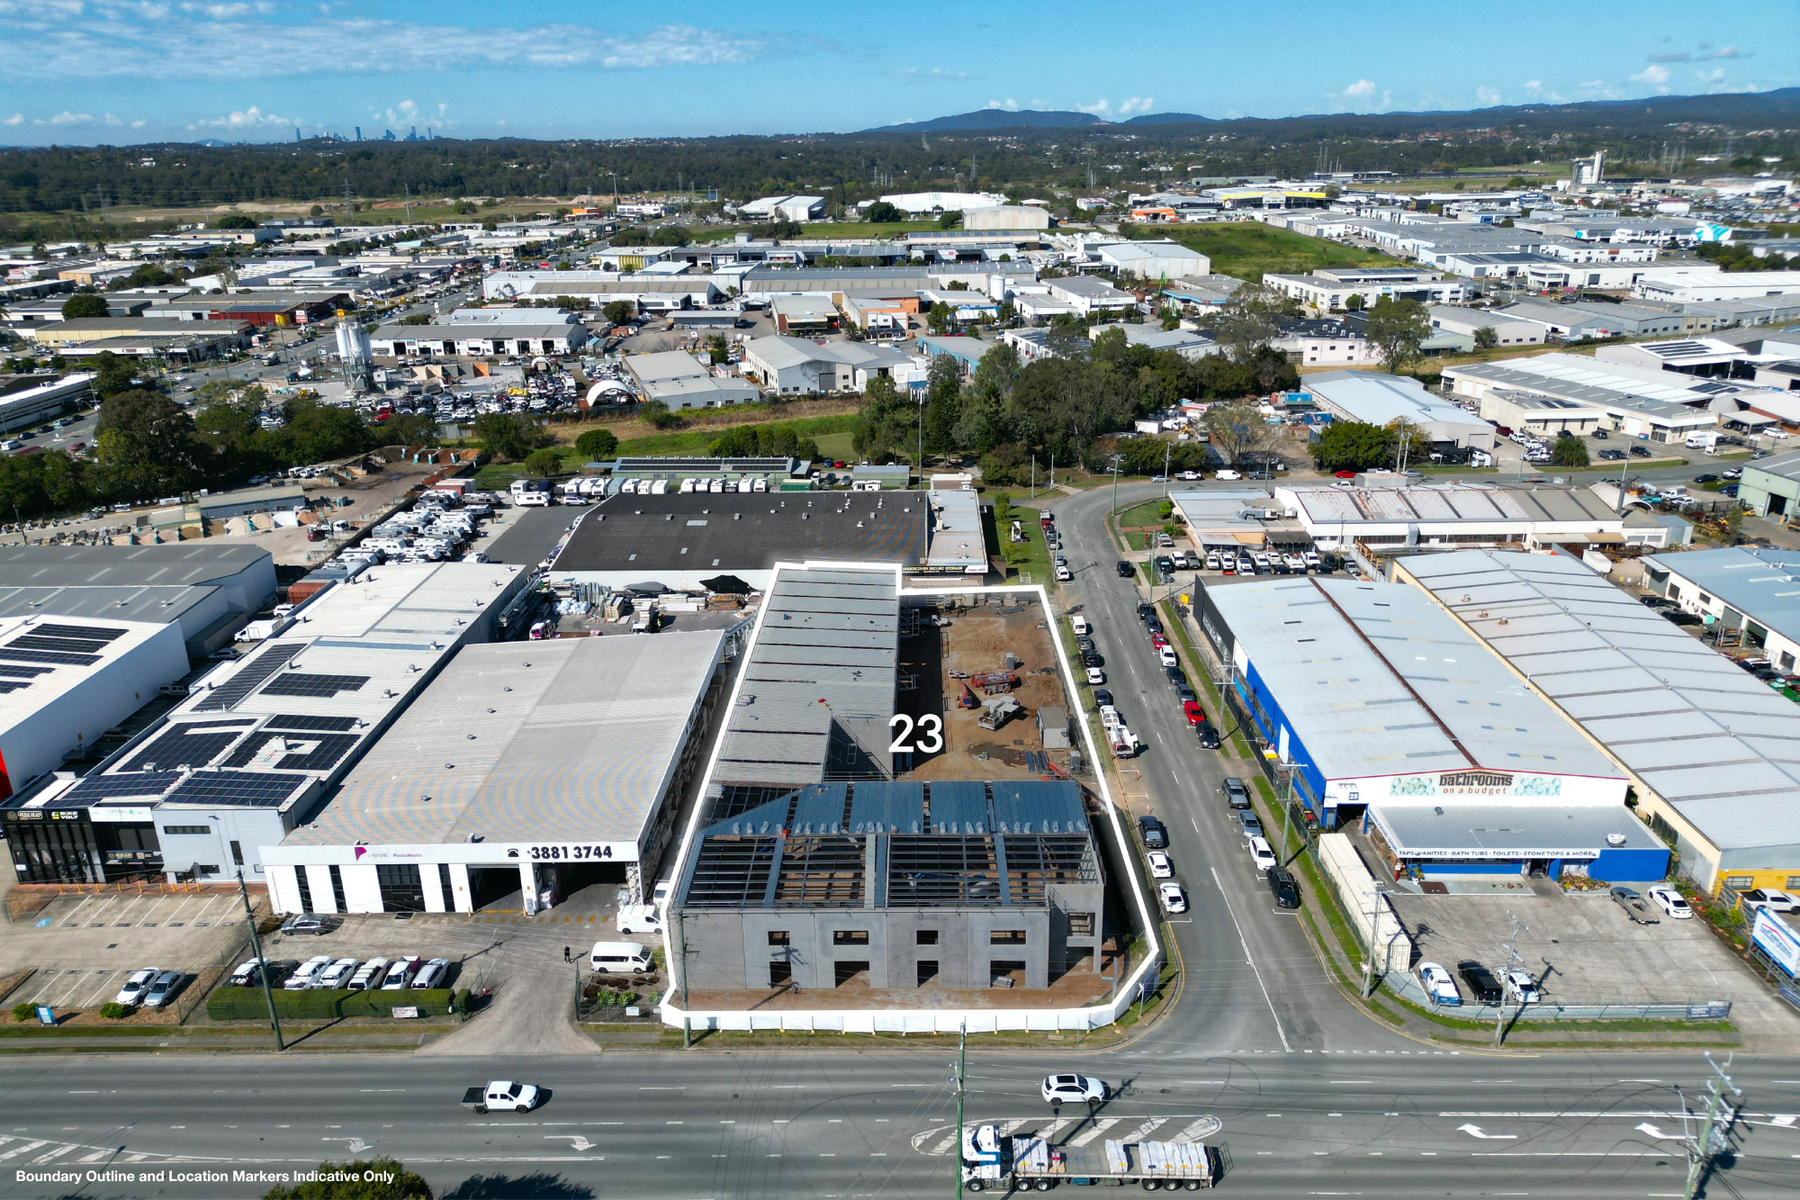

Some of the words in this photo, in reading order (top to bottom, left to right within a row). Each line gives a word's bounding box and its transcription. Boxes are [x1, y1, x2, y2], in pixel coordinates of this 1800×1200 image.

[1439, 772, 1512, 786] bathrooms
[1468, 787, 1506, 796] budget
[531, 846, 568, 859] 3881
[573, 845, 613, 859] 3744
